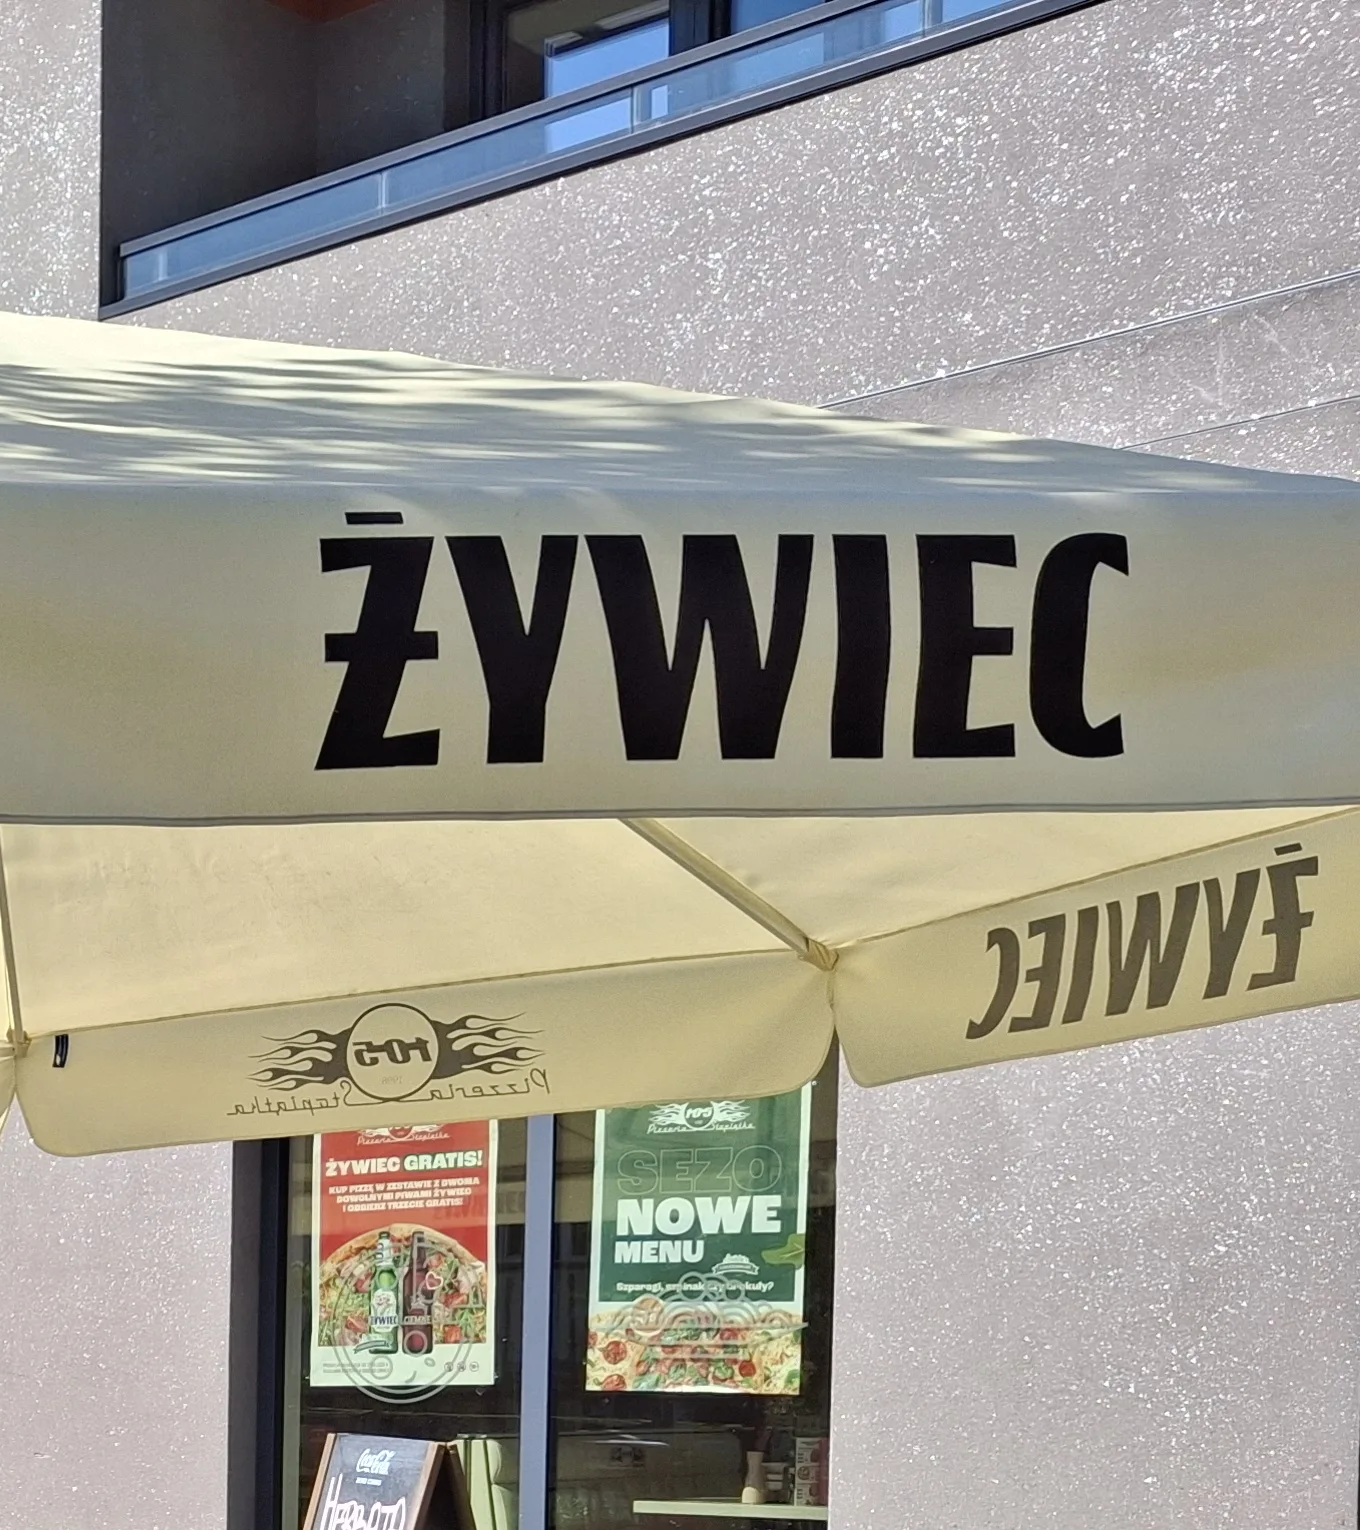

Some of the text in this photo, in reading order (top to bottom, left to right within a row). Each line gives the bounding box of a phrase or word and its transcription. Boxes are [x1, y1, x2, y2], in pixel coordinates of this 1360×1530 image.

[314, 511, 1129, 771] ŻYWIEC
[325, 1150, 484, 1177] ŻYWIEC GRATIS!
[617, 1145, 782, 1195] SEZO
[616, 1194, 782, 1236] NOWE
[614, 1239, 705, 1264] MENU
